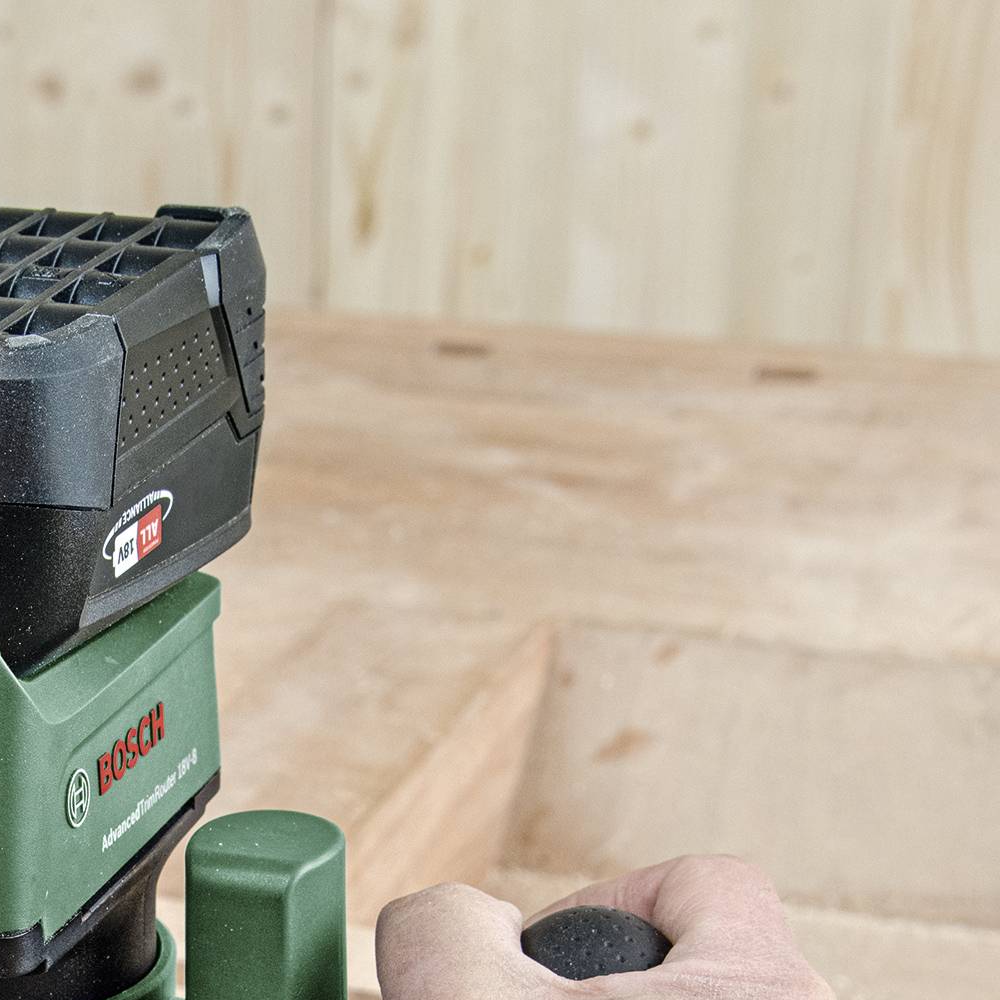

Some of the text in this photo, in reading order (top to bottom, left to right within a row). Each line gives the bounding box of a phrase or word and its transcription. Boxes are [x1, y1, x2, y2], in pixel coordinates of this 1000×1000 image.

[118, 538, 135, 565] 18V
[140, 519, 159, 545] ALL
[97, 701, 165, 797] BOSCH
[102, 748, 198, 853] AdvancedTrimRouter 18V-8
